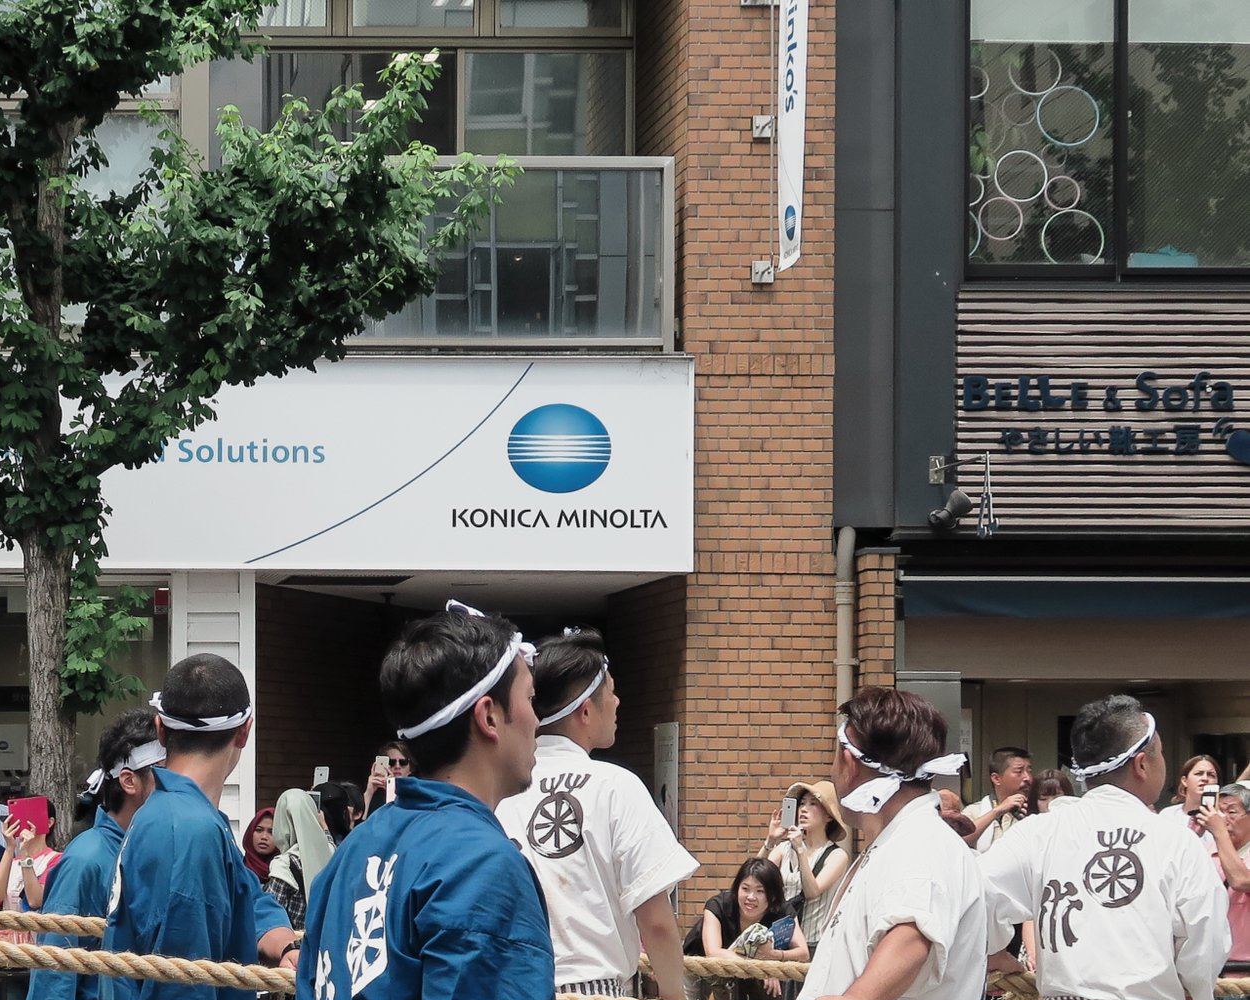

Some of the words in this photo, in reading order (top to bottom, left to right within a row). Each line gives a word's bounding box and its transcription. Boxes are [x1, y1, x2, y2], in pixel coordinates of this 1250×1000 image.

[785, 0, 798, 113] inko's
[1103, 386, 1122, 411] &
[1135, 371, 1234, 412] Sofa
[178, 438, 326, 463] Solutions
[1001, 425, 1200, 455] やさしい靴工房
[452, 508, 550, 528] KONICA
[557, 509, 668, 528] MINOLTA
